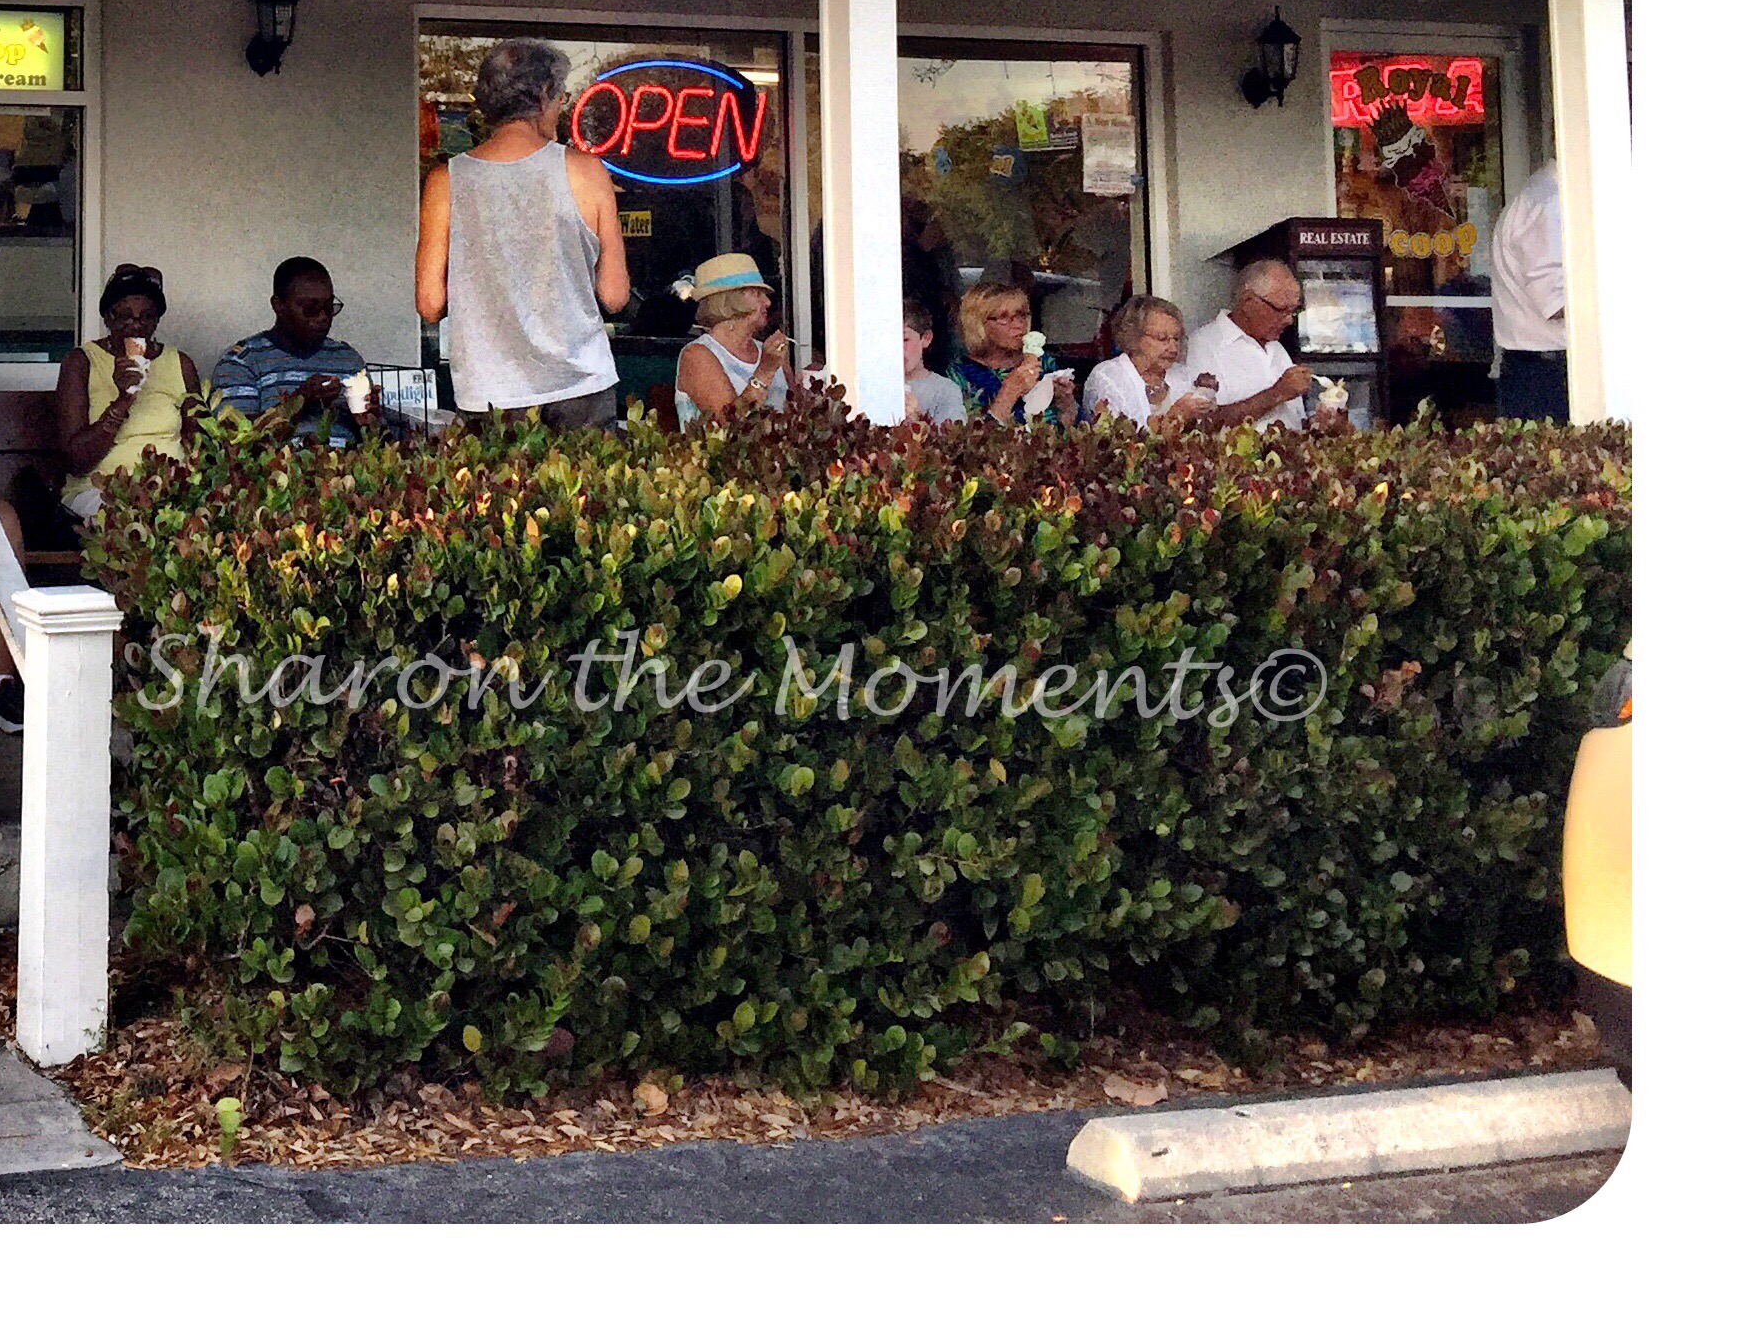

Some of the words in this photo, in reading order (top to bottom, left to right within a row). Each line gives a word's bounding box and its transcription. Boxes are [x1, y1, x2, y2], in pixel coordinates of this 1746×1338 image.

[1354, 65, 1472, 110] Royal
[571, 80, 767, 162] OPEN
[619, 213, 650, 234] Water
[1299, 232, 1328, 245] REAL
[1331, 232, 1370, 245] ESTATE
